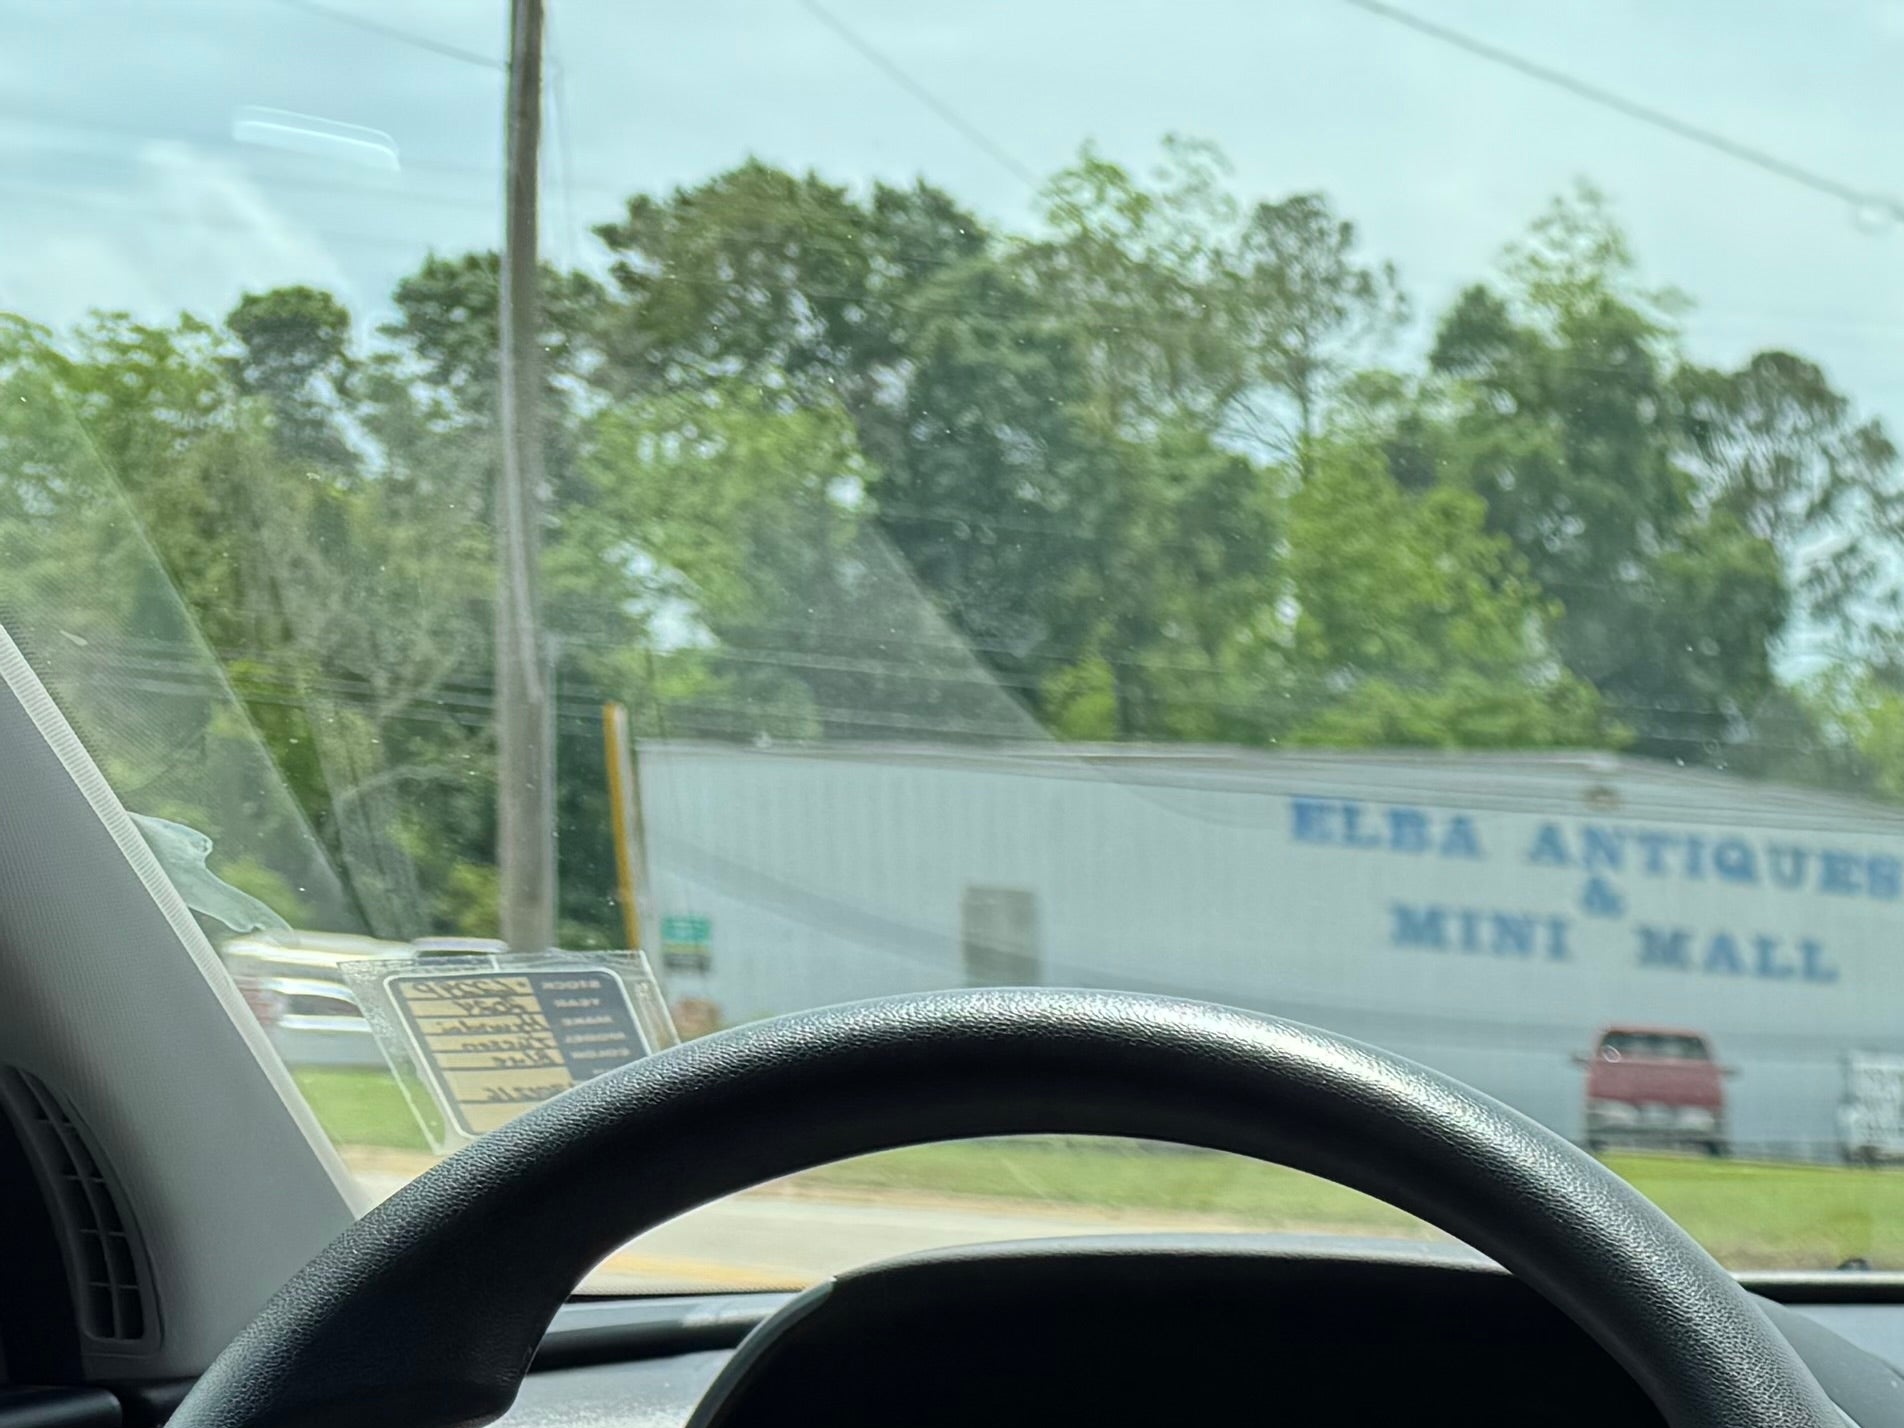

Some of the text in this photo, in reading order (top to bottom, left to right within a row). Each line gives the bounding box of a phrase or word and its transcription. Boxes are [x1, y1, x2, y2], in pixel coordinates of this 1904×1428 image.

[1290, 796, 1484, 857] ELBA
[1580, 877, 1624, 914] &
[1390, 905, 1840, 982] MINI MALL
